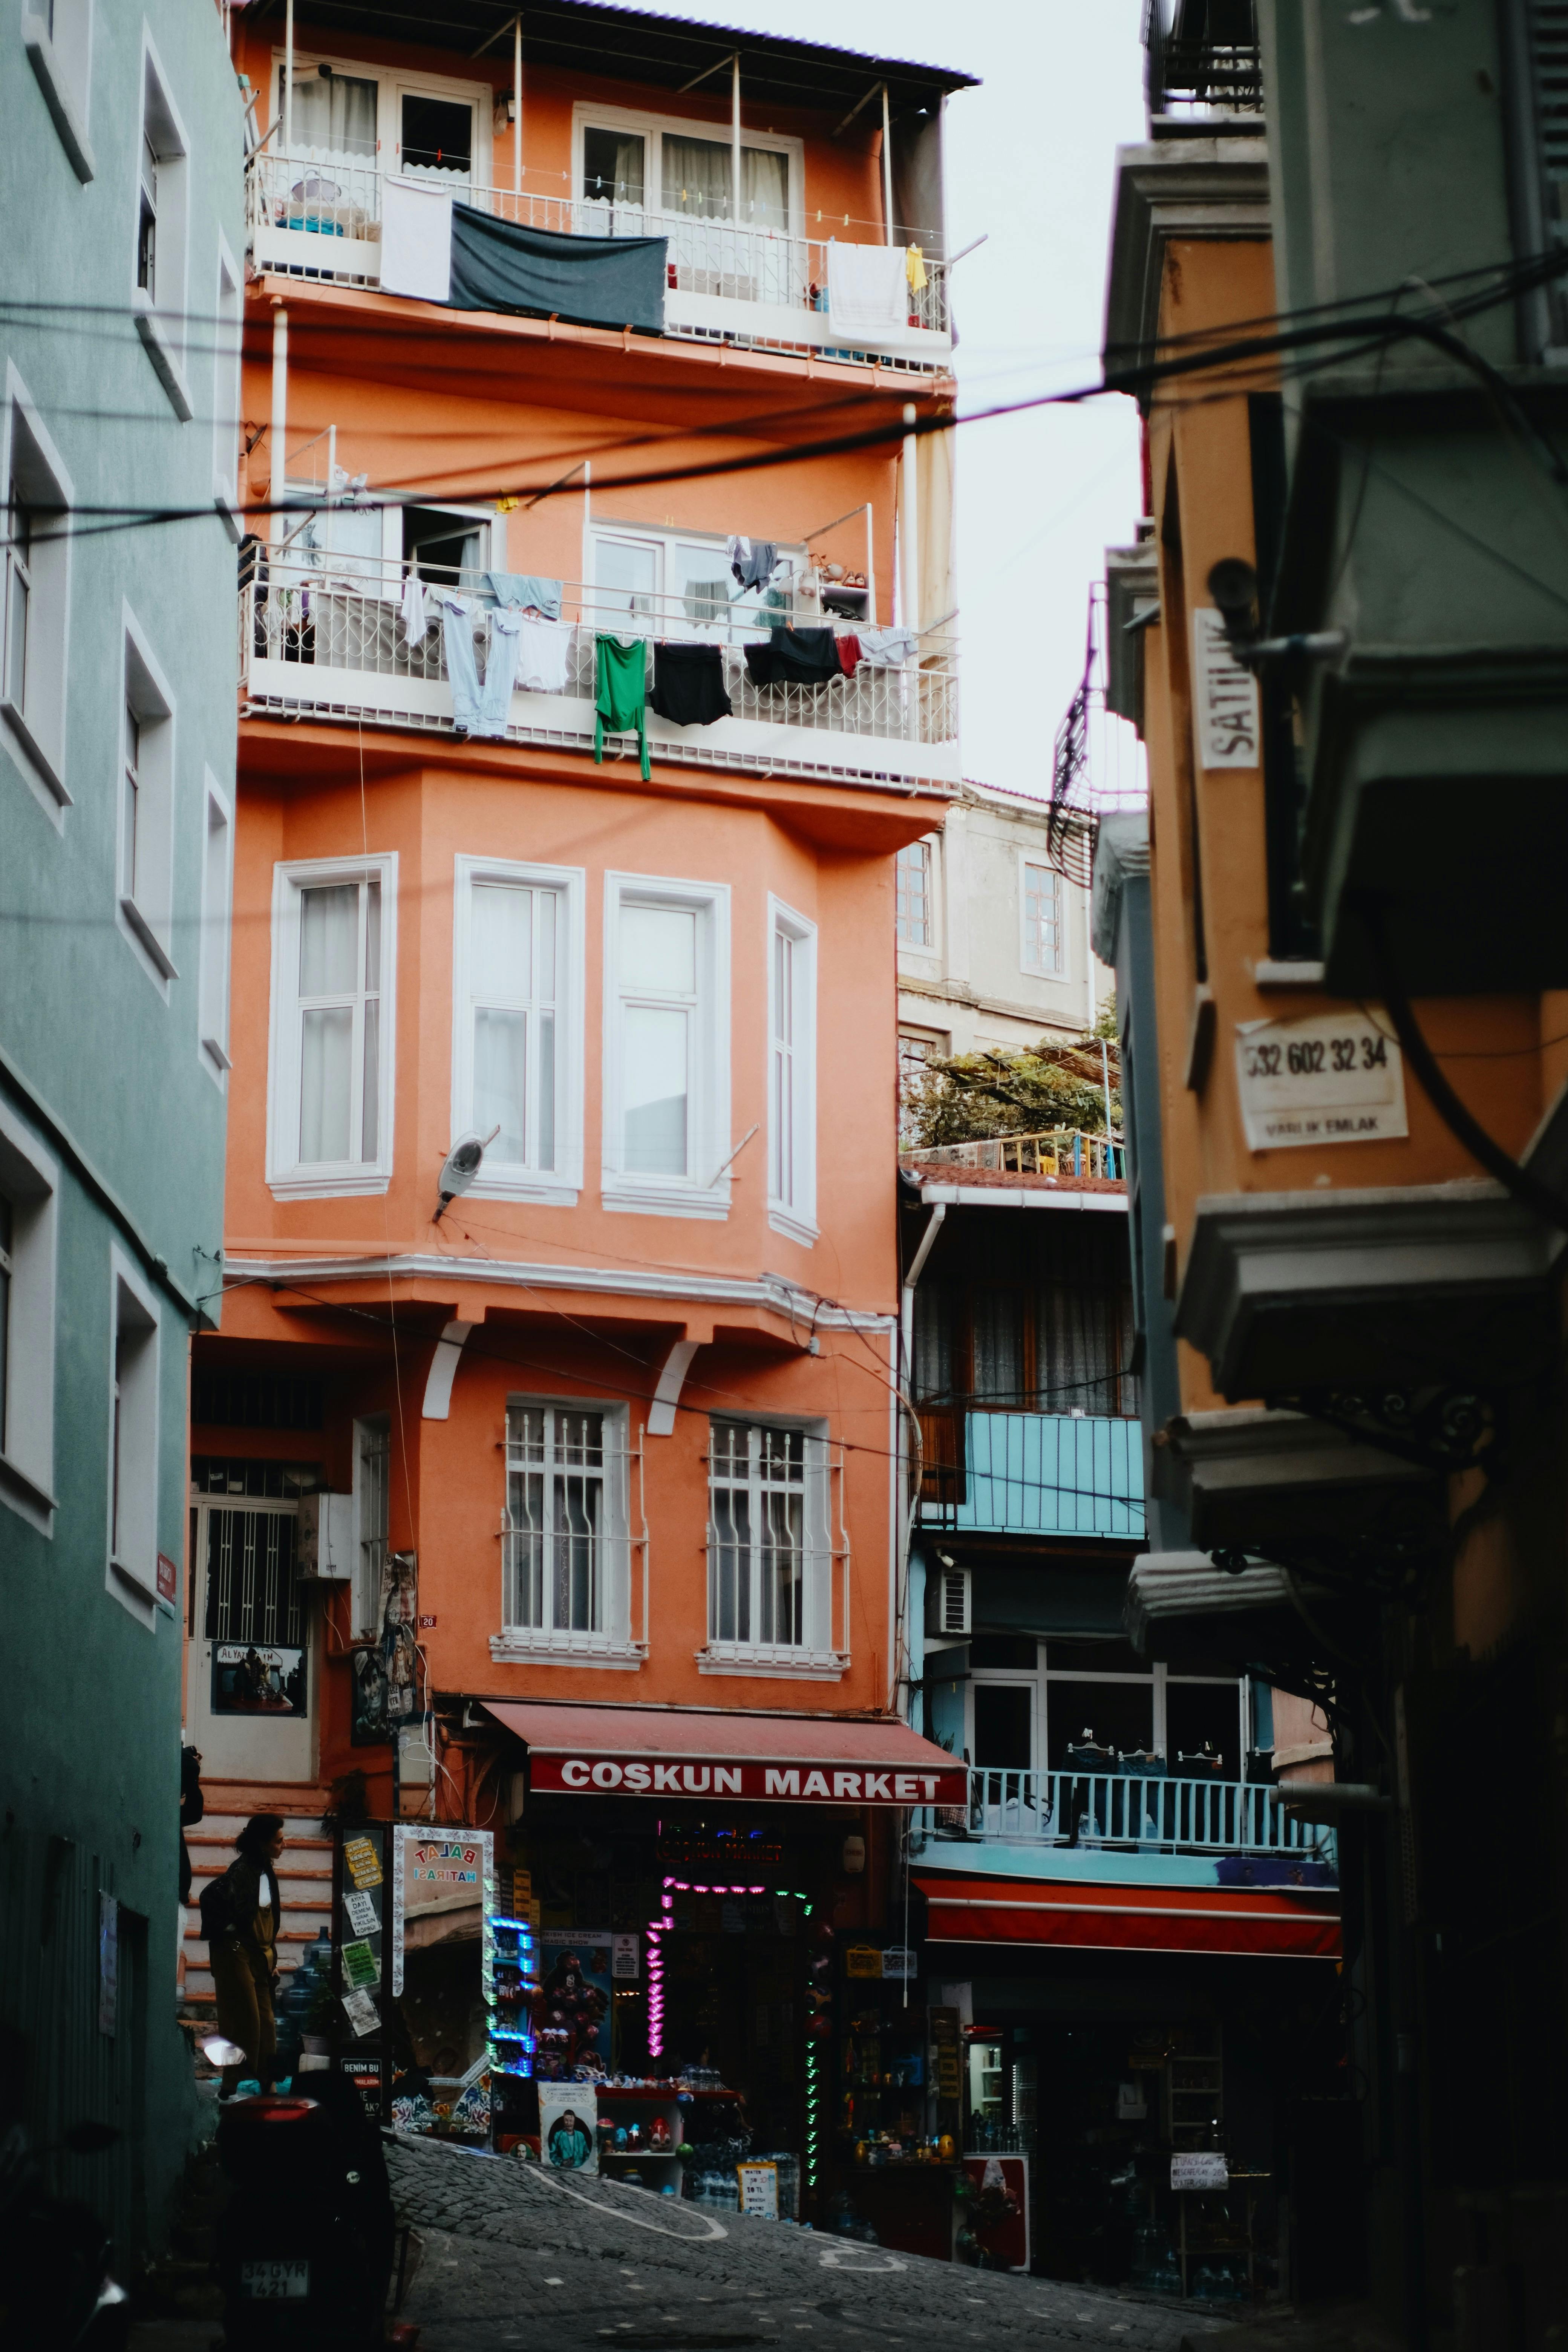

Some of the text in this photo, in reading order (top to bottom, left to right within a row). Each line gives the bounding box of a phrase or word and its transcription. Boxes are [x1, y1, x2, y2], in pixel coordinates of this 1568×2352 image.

[1288, 1041, 1326, 1074] 602
[1331, 1038, 1356, 1071] 32
[1361, 1035, 1387, 1070] 34
[1326, 1117, 1378, 1135] EMLAK
[423, 1618, 433, 1626] 20
[222, 1648, 273, 1661] AL YAZIM
[561, 1760, 941, 1800] COŞKUN MARKET
[725, 1842, 782, 1861] MARKET
[352, 1906, 371, 1915] DEMEM
[345, 2063, 379, 2073] BENİM BU
[364, 2103, 380, 2112] AK?
[244, 2263, 266, 2279] 34
[256, 2280, 287, 2296] 421
